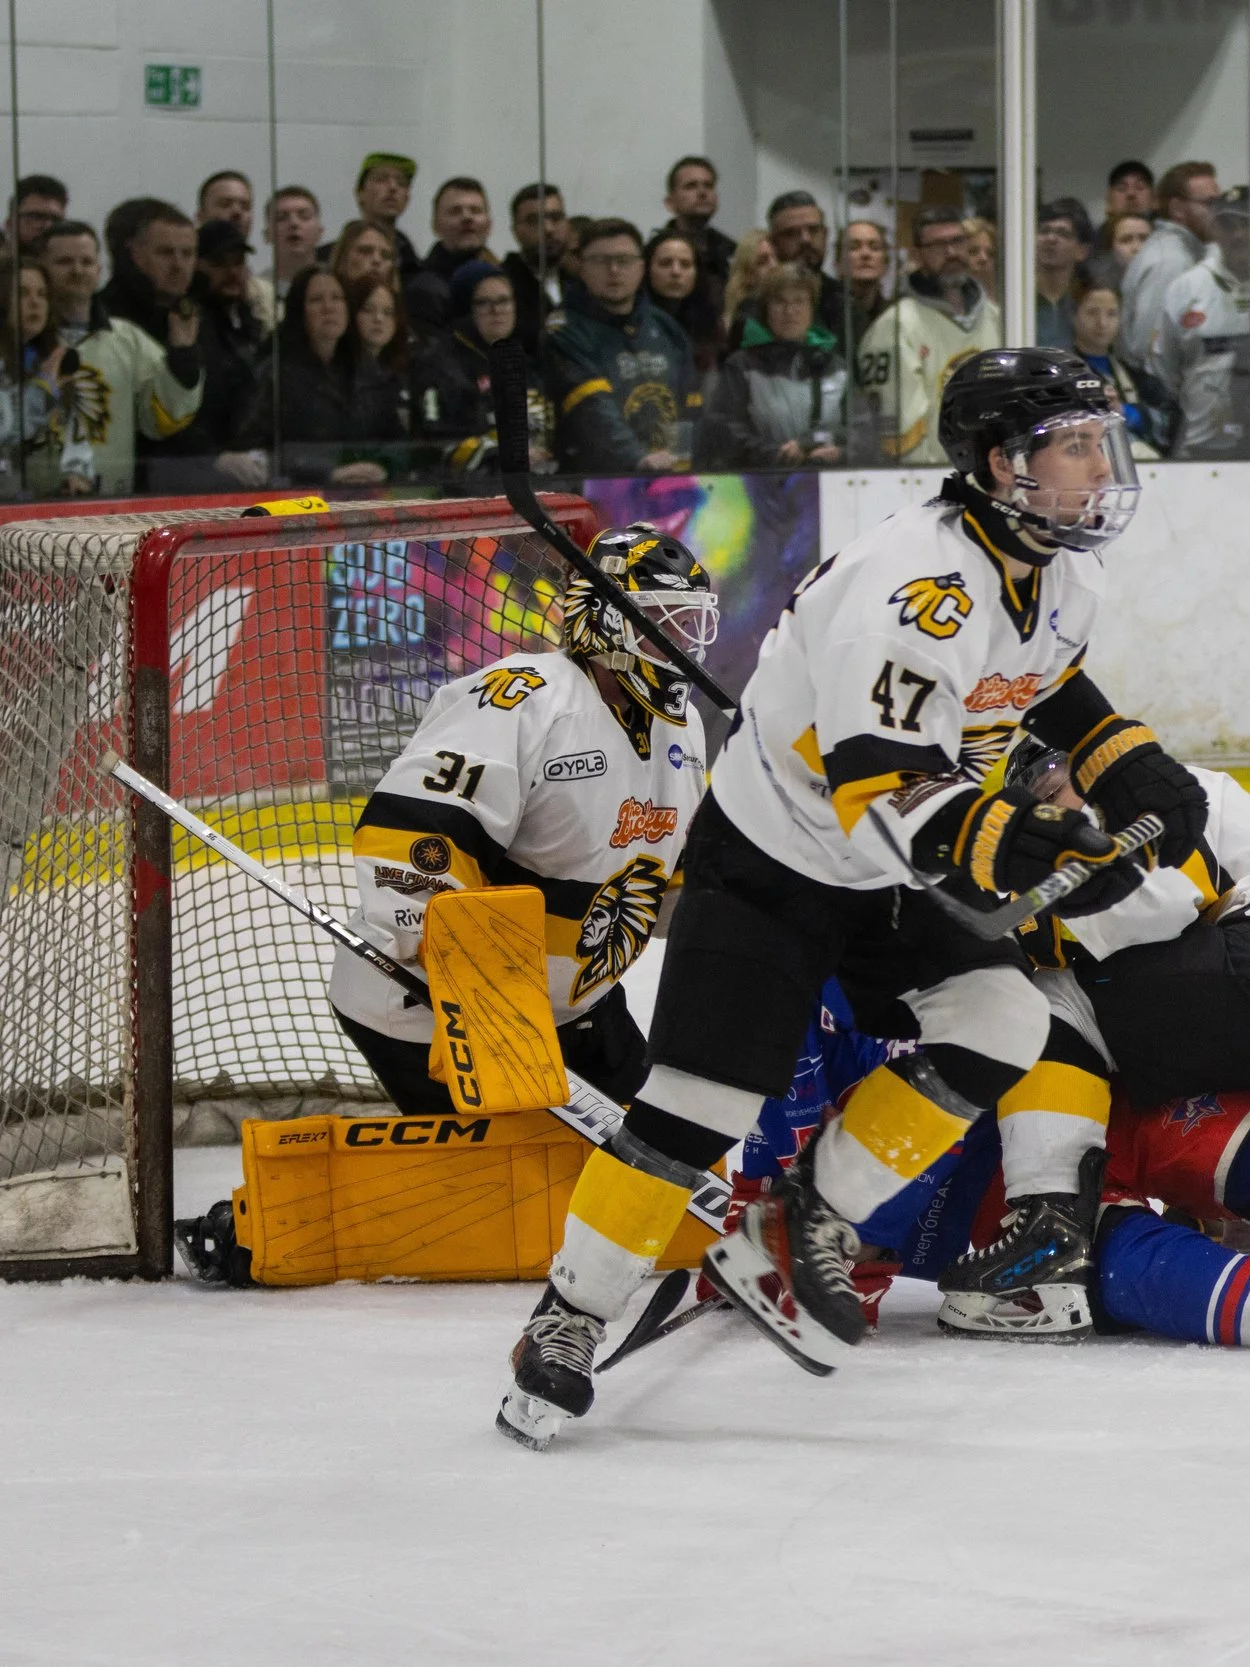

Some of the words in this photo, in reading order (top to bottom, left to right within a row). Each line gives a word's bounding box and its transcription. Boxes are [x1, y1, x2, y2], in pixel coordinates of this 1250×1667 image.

[331, 594, 425, 648] ZERO
[871, 660, 937, 733] 47
[636, 732, 650, 754] 31
[423, 750, 486, 805] 31
[364, 949, 396, 973] PRO
[441, 1000, 482, 1108] CCM
[345, 1119, 491, 1147] CCM
[993, 1239, 1057, 1288] CCM
[948, 1304, 967, 1318] CCM
